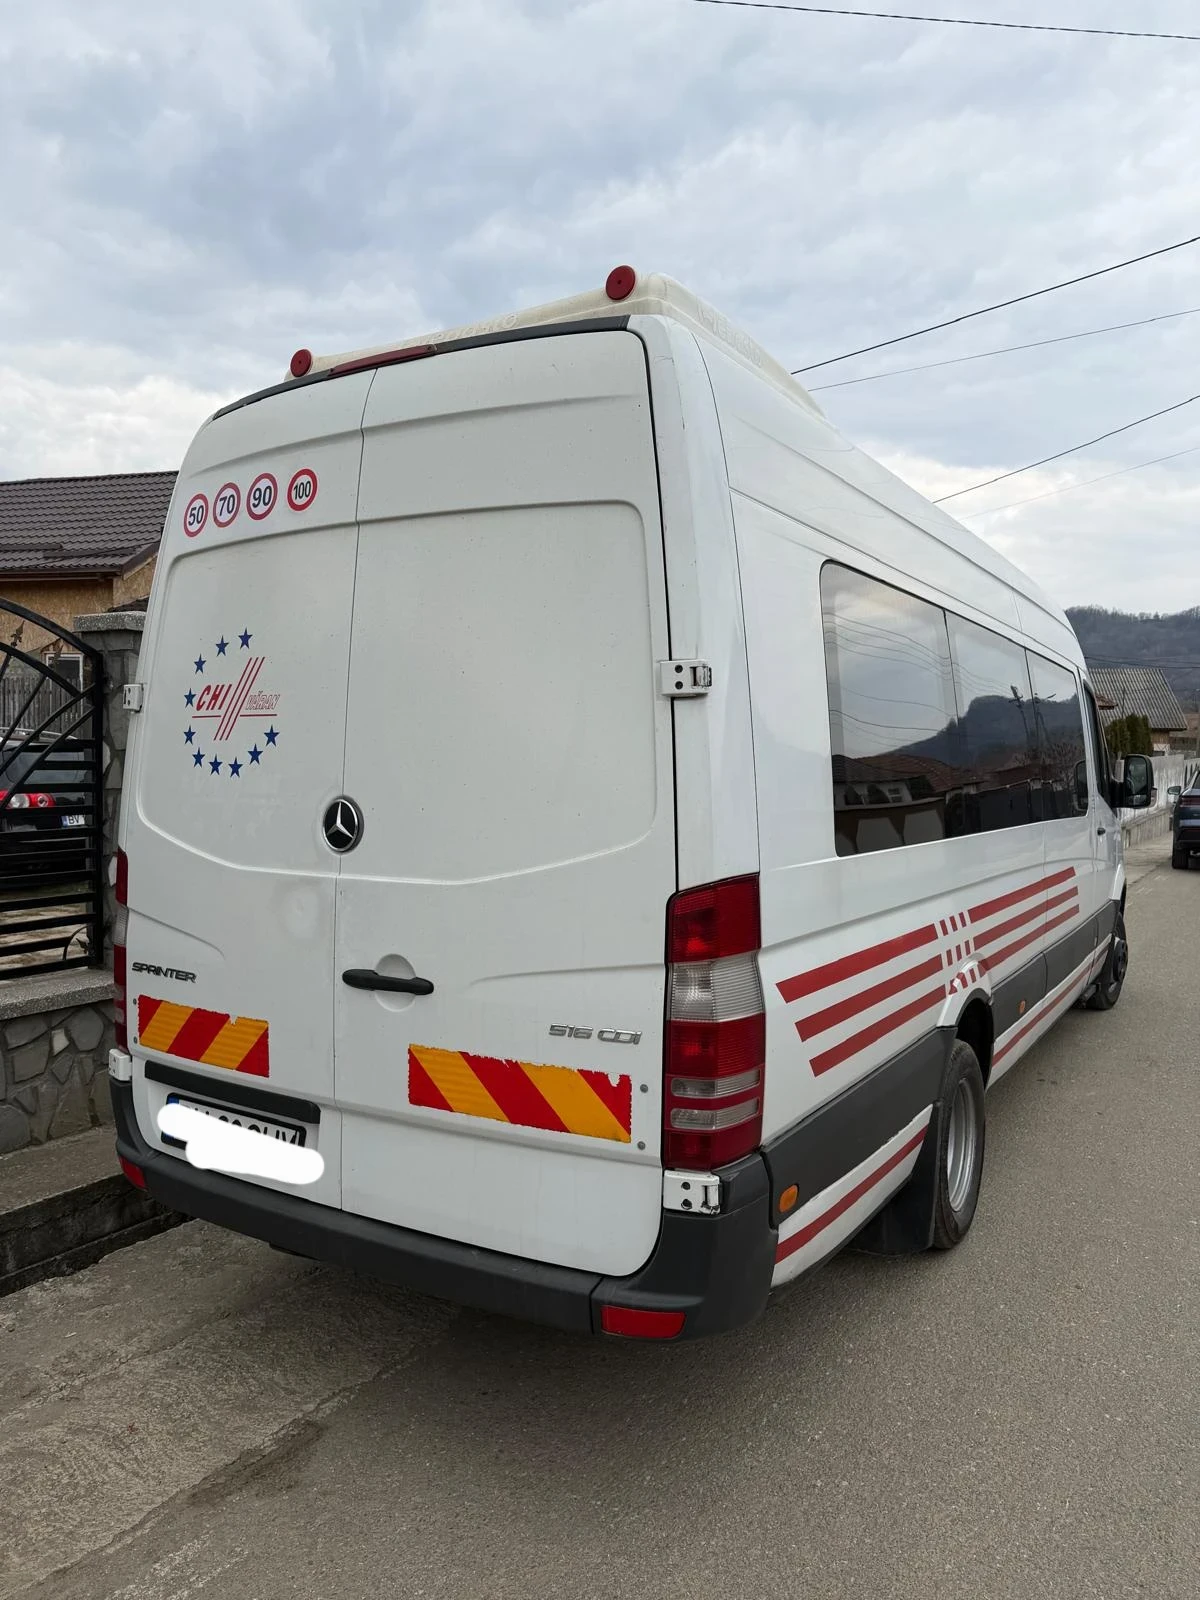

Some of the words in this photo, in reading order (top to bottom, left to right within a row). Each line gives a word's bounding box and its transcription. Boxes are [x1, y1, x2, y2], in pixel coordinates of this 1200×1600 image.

[188, 505, 204, 526] 50
[219, 494, 236, 517] 70
[252, 485, 273, 508] 90
[293, 480, 312, 500] 100
[196, 684, 232, 711] CHI
[132, 962, 197, 983] SPRINTER
[549, 1023, 593, 1039] 516
